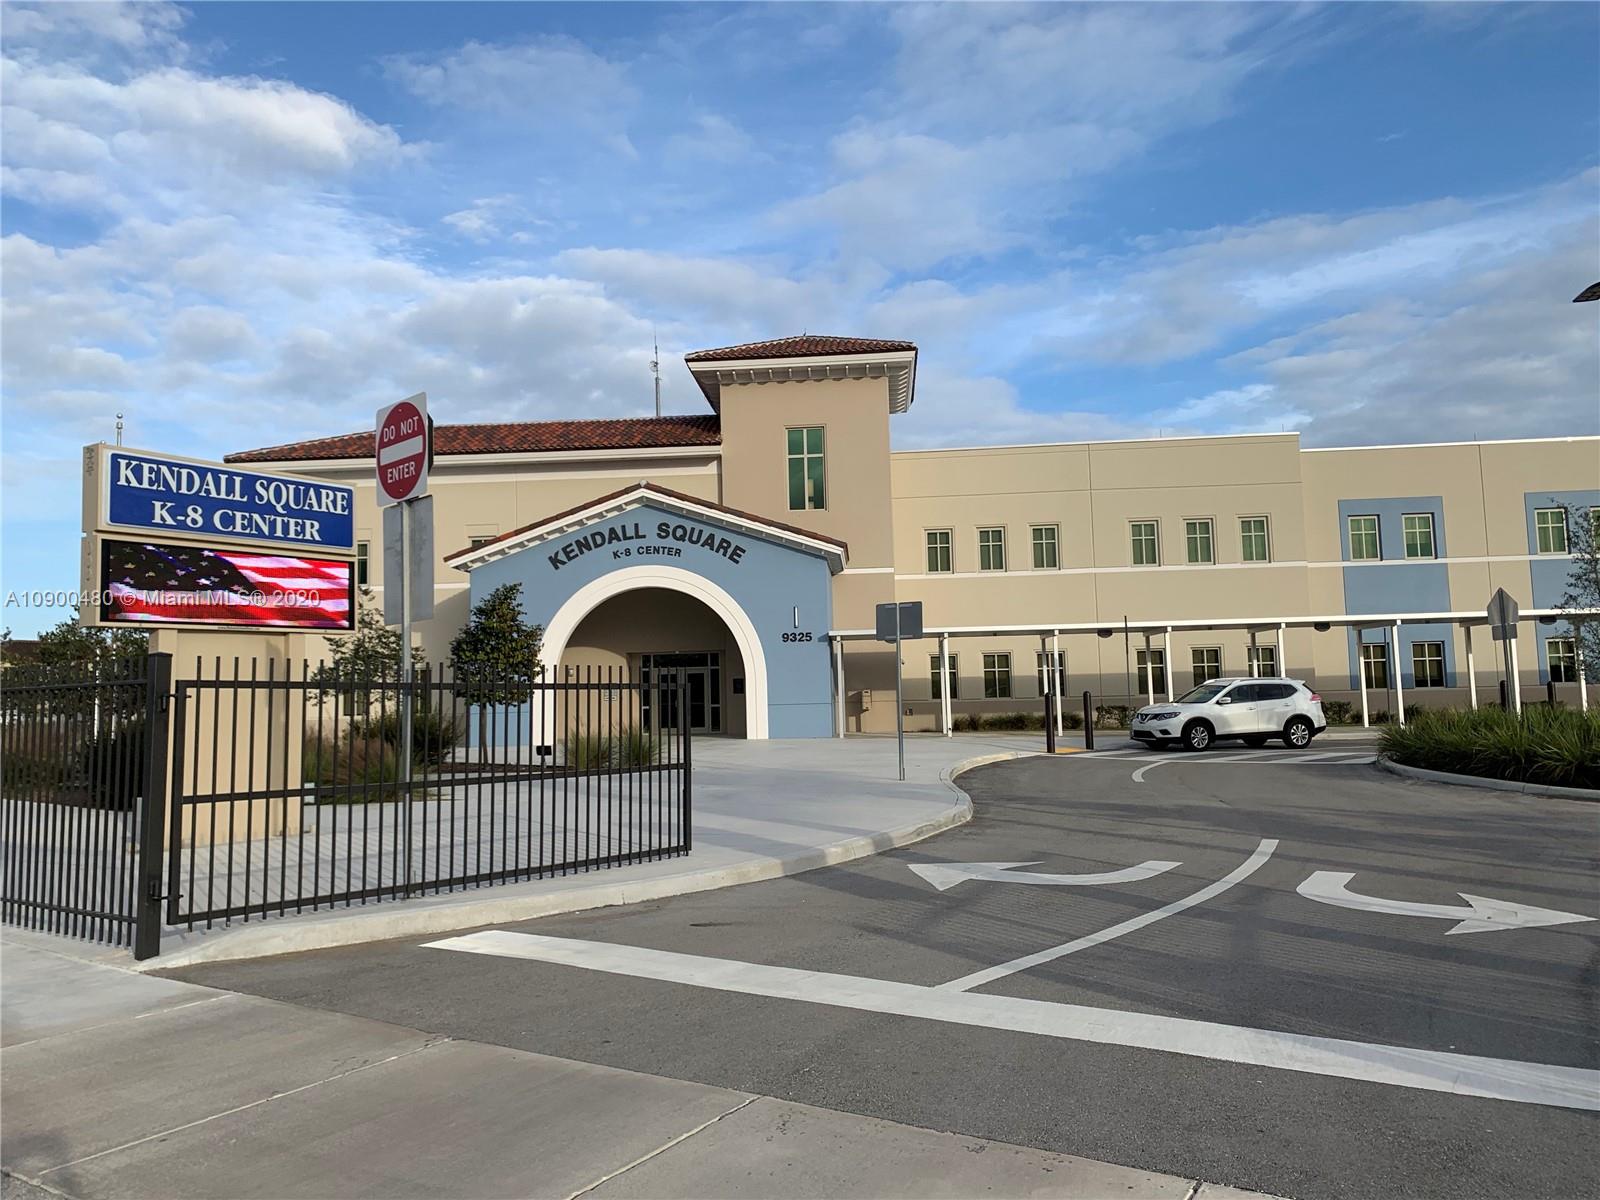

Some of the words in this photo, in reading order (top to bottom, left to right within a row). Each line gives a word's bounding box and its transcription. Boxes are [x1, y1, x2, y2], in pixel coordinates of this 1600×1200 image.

[383, 425, 396, 442] DO
[400, 416, 419, 436] NOT
[387, 461, 416, 483] ENTER
[116, 458, 248, 502] KENDALL
[254, 479, 349, 515] SQUARE
[151, 501, 204, 528] K-8
[213, 509, 322, 542] CENTER
[548, 522, 646, 570] KENDALL
[656, 522, 746, 564] SQUARE
[612, 548, 632, 560] K-8
[637, 545, 682, 557] CENTER
[781, 632, 813, 643] 9325
